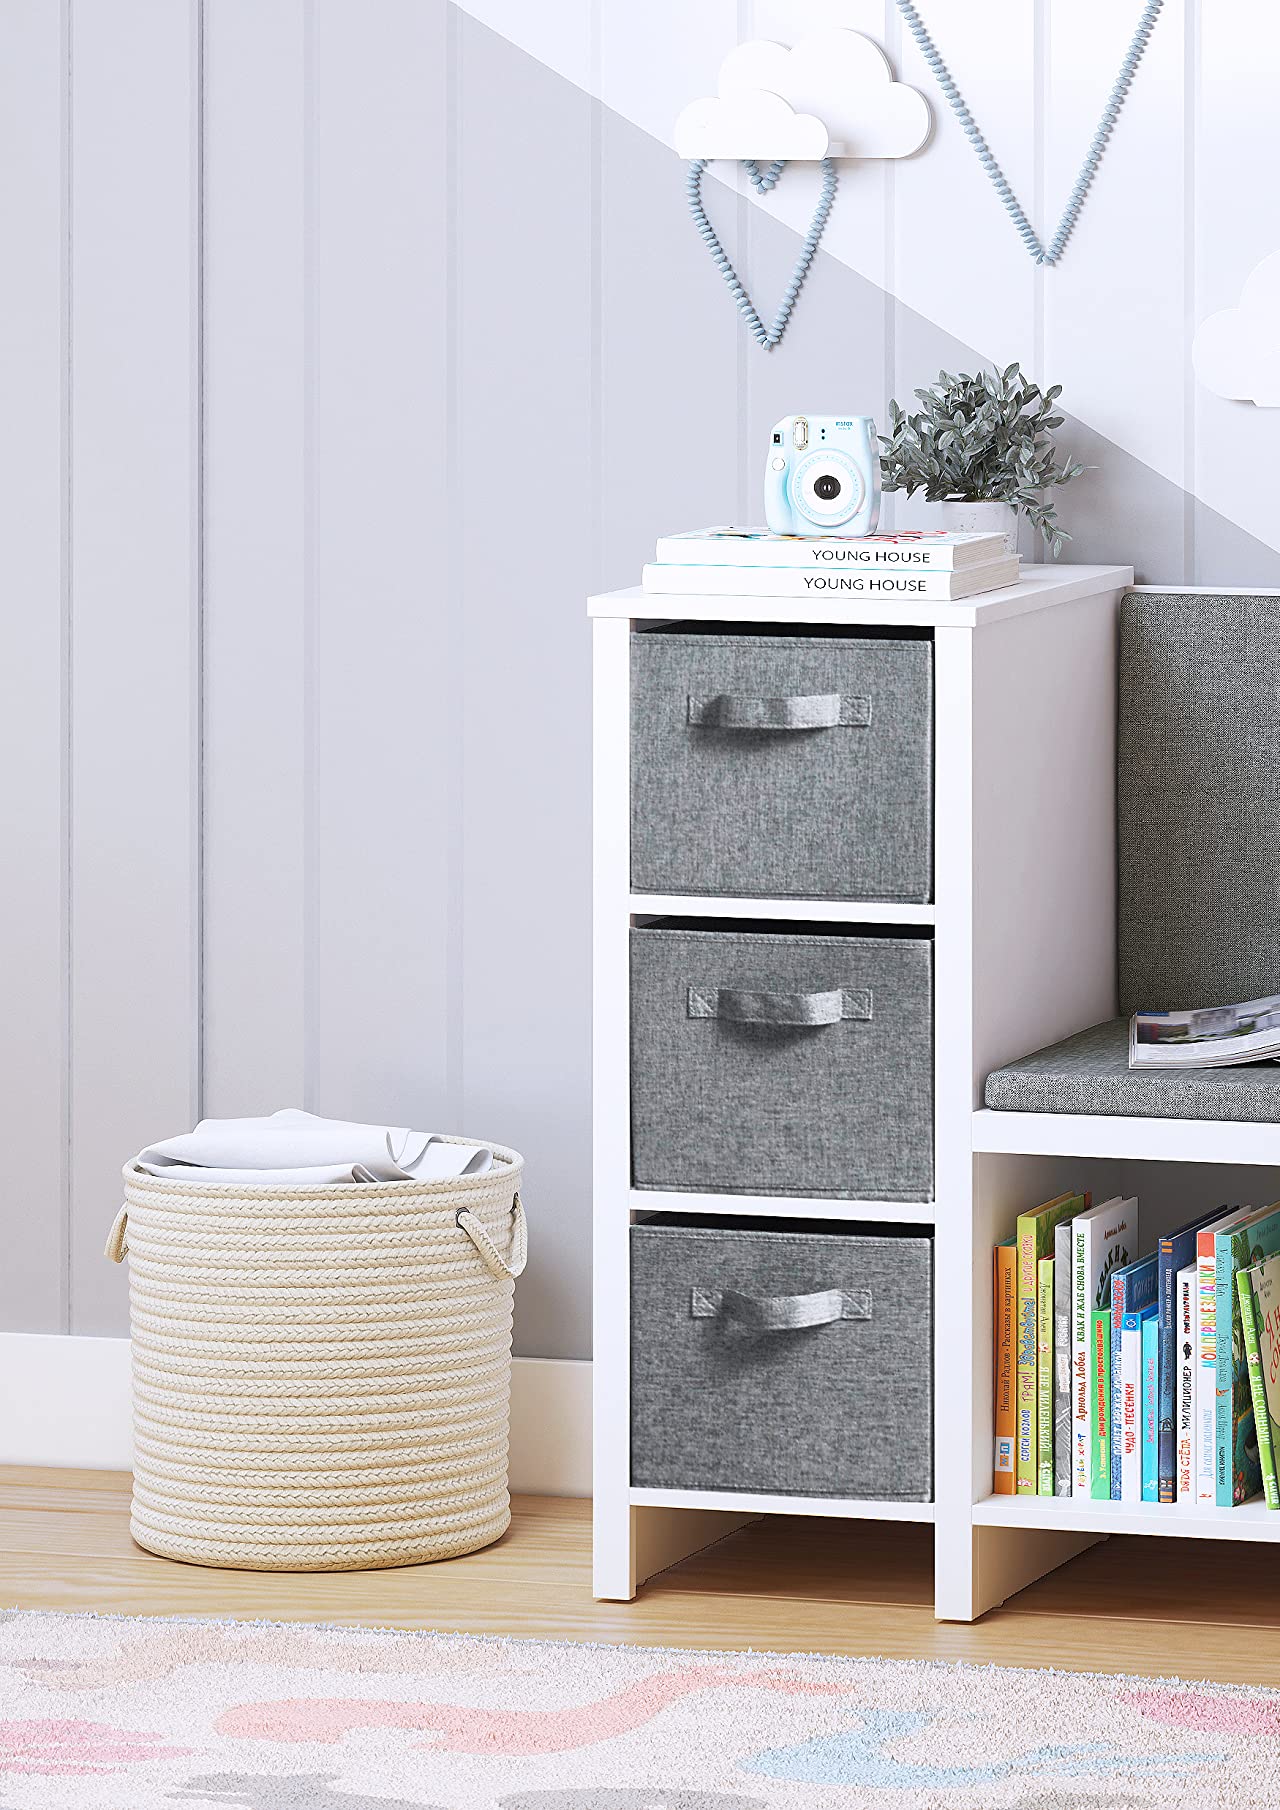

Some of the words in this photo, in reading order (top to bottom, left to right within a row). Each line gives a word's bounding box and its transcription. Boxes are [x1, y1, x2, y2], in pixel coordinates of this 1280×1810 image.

[812, 550, 871, 562] YOUNG
[875, 551, 930, 563] HOUSE
[804, 577, 864, 590] YOUNG
[870, 579, 927, 592] HOUSE
[1076, 1233, 1085, 1264] ВМЕСТЕ
[1003, 1267, 1014, 1306] картинках
[1076, 1266, 1085, 1291] СНОВА
[1199, 1265, 1216, 1307] ЗАГАДКИ
[1076, 1292, 1085, 1311] ЖАБ
[1002, 1314, 1012, 1347] Рассказы
[1018, 1297, 1036, 1366] Здравствуйте!
[1076, 1320, 1085, 1343] КВАК
[1200, 1308, 1216, 1344] ПЕРВЫЕ
[1096, 1319, 1106, 1377] простоквашино
[1200, 1346, 1216, 1368] МОИ
[1001, 1353, 1012, 1378] Радлов
[1073, 1351, 1086, 1379] Лобел
[1000, 1379, 1011, 1412] Николай
[1018, 1371, 1035, 1402] ТРЯМ!
[1040, 1375, 1050, 1387] НЕ
[1253, 1383, 1264, 1398] НЕ
[1075, 1381, 1087, 1421] Арнольд
[1097, 1384, 1107, 1422] рождения
[1124, 1383, 1135, 1426] ПЕСЕНКИ
[1181, 1365, 1192, 1430] МИЛИЦИОНЕР
[1021, 1409, 1031, 1437] КОЗЛОВ
[1040, 1389, 1053, 1453] МИЛЕНЬКИЙ!
[1124, 1431, 1136, 1454] ЧУДО
[1178, 1437, 1191, 1467] СТЁПА
